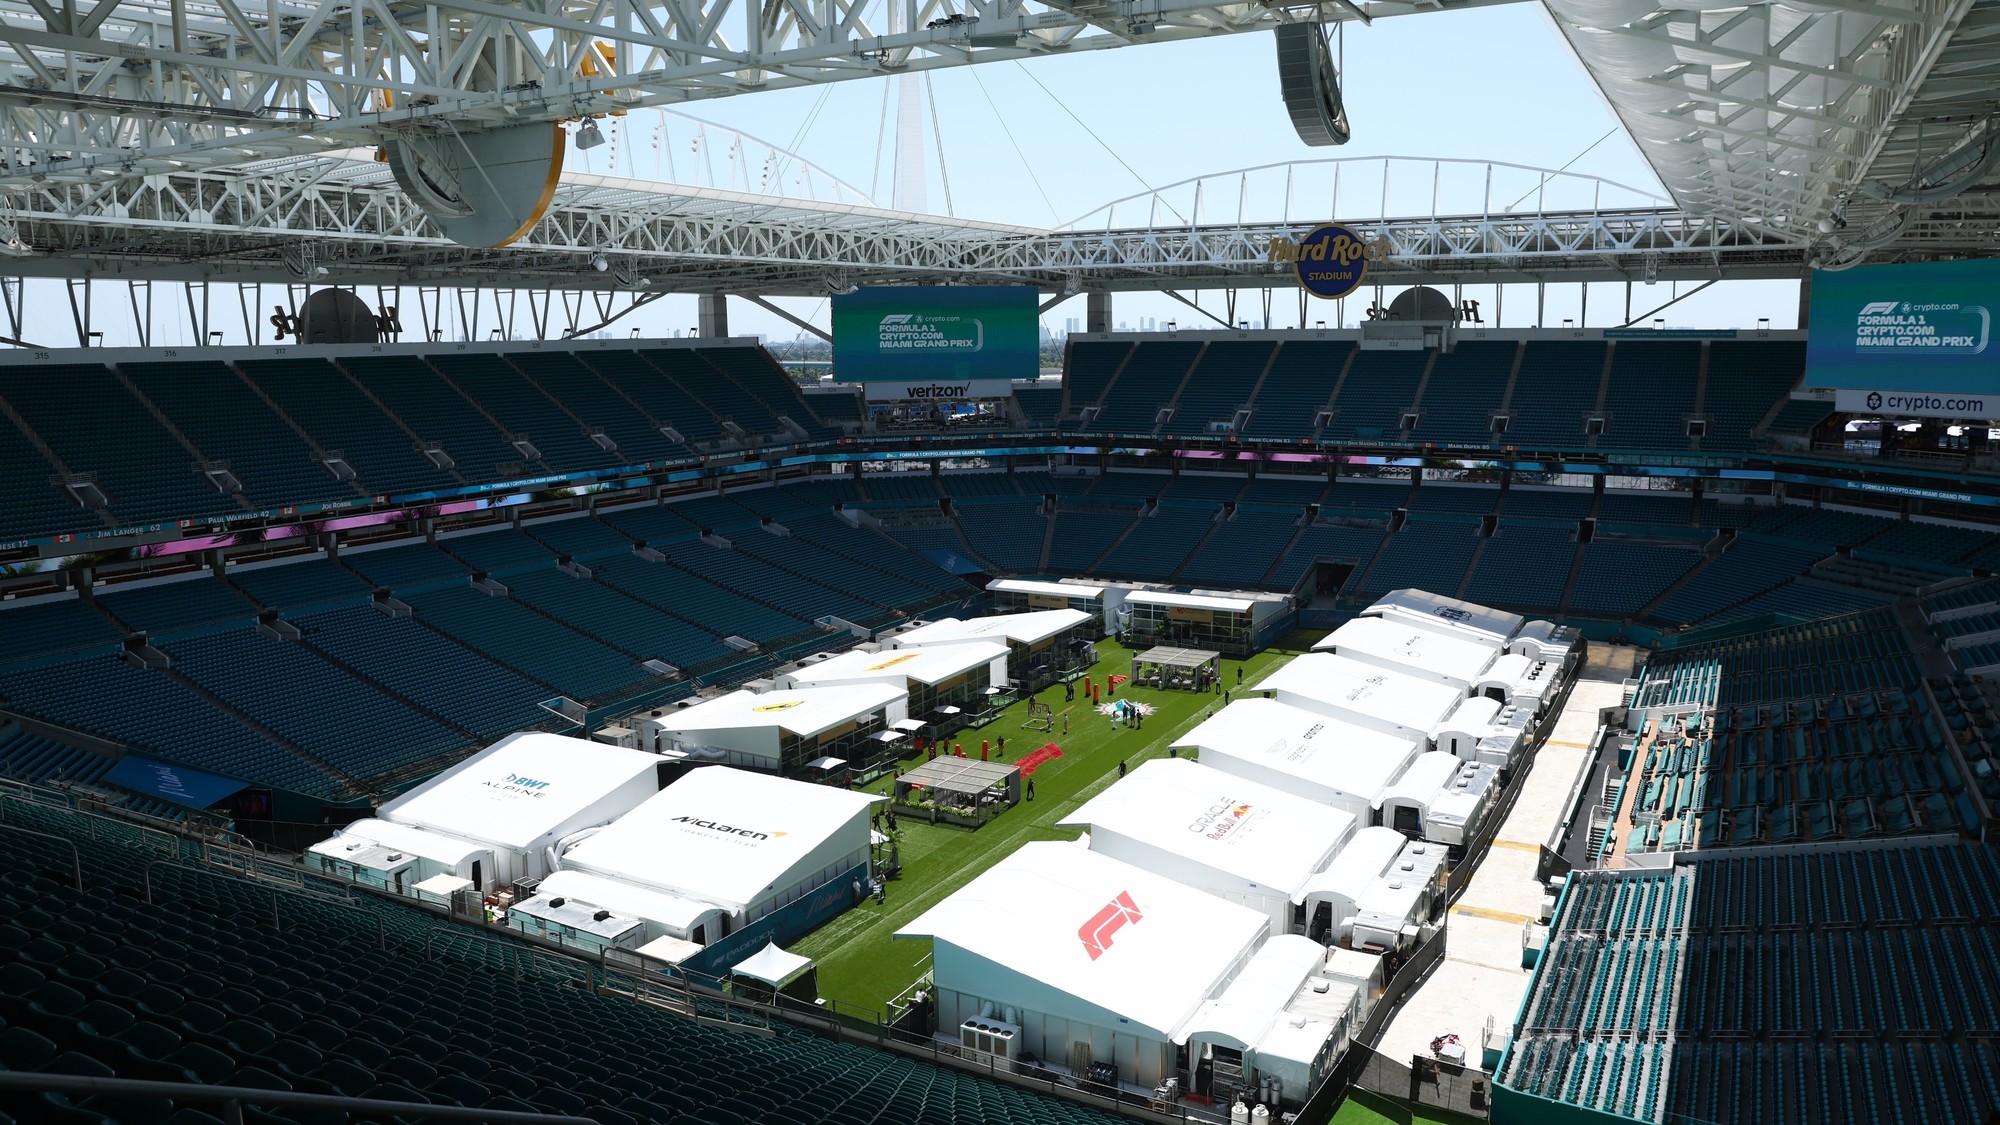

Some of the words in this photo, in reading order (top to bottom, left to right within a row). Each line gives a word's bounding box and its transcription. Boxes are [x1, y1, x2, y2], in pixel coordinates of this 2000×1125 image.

[1268, 236, 1329, 262] Hard
[1331, 235, 1391, 265] Rock
[1309, 272, 1352, 280] STADIUM
[1858, 316, 1916, 325] FORMULA
[1918, 316, 1926, 324] 1
[1857, 326, 1934, 335] CRYPTO.COM
[1856, 337, 1894, 346] MIAMI
[1896, 337, 1940, 346] GRAND
[1942, 336, 1974, 346] PRIX
[907, 384, 964, 398] verizon
[1888, 397, 1983, 411] crypto.com
[1889, 487, 1921, 495] CRYPTO.COM
[226, 513, 258, 522] WARFIELD
[97, 530, 110, 538] JIM
[114, 527, 144, 536] LANGER
[150, 524, 161, 532] 62
[481, 781, 546, 798] ALPINE
[514, 777, 550, 790] BWT
[1188, 796, 1236, 833] ORACLE
[670, 816, 768, 840] McLaren
[726, 928, 775, 960] PADDOCK
